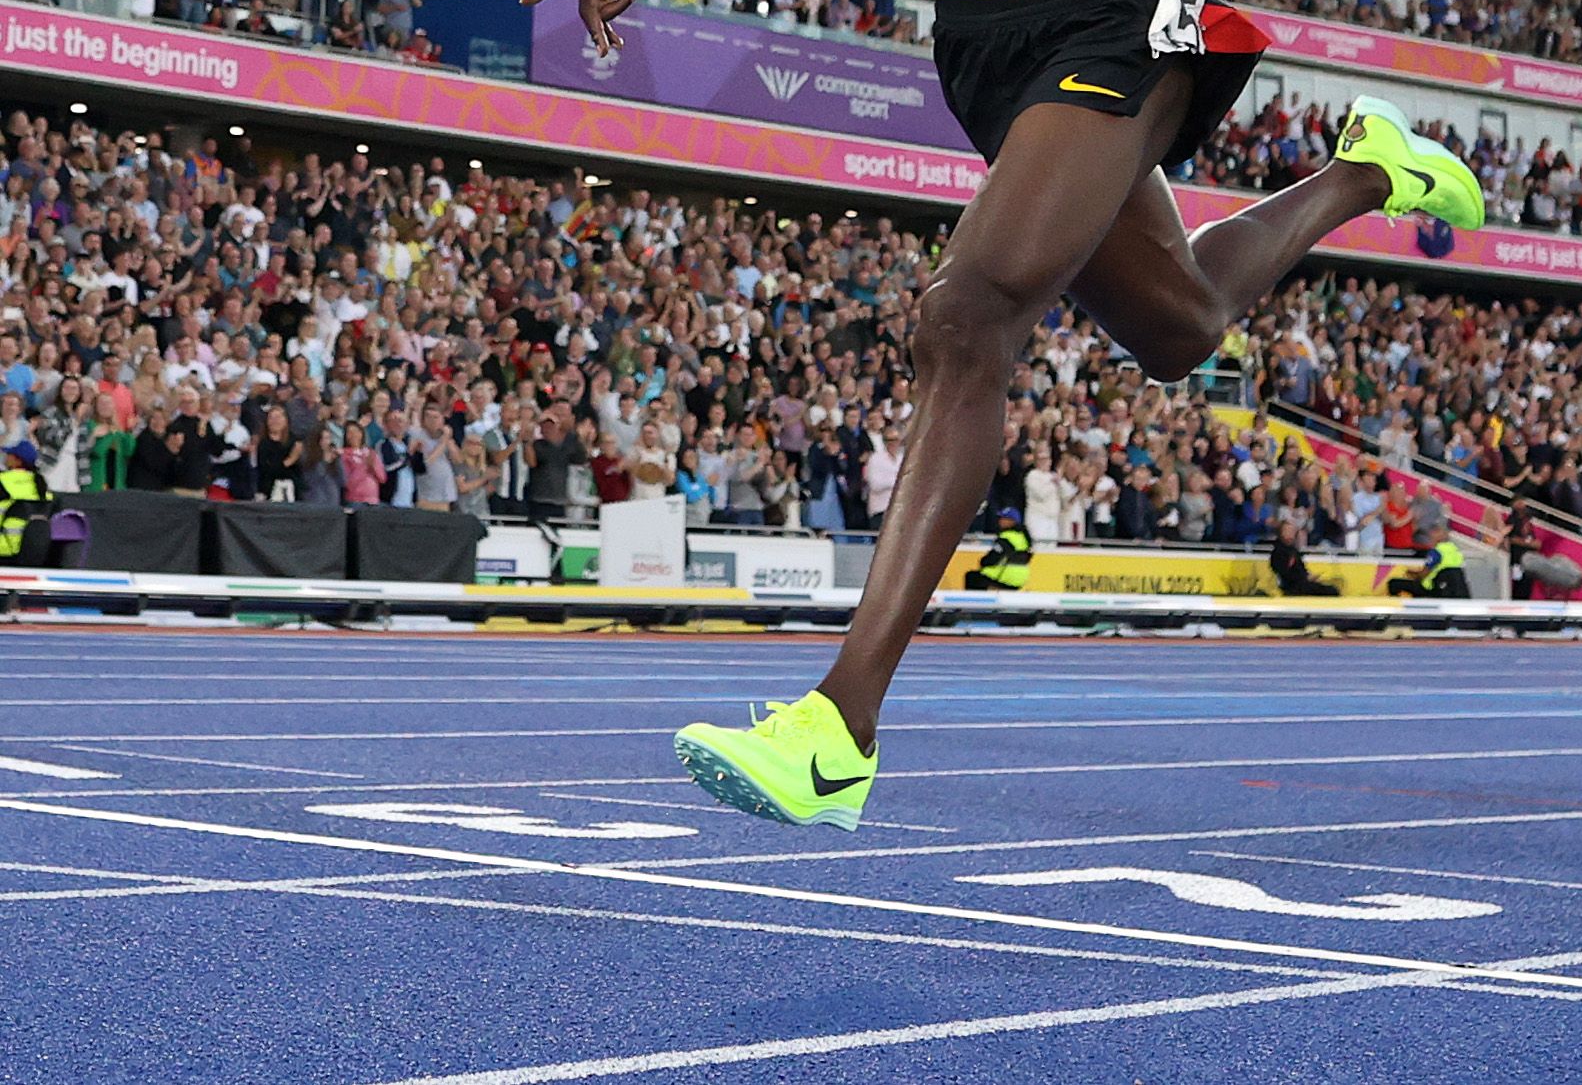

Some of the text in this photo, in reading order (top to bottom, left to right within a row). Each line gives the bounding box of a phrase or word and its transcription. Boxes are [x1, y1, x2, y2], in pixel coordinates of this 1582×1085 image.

[4, 17, 59, 54] just
[63, 26, 108, 62] the
[112, 33, 239, 89] beginning
[844, 153, 897, 180] sport
[899, 154, 915, 182] is
[916, 159, 952, 189] just
